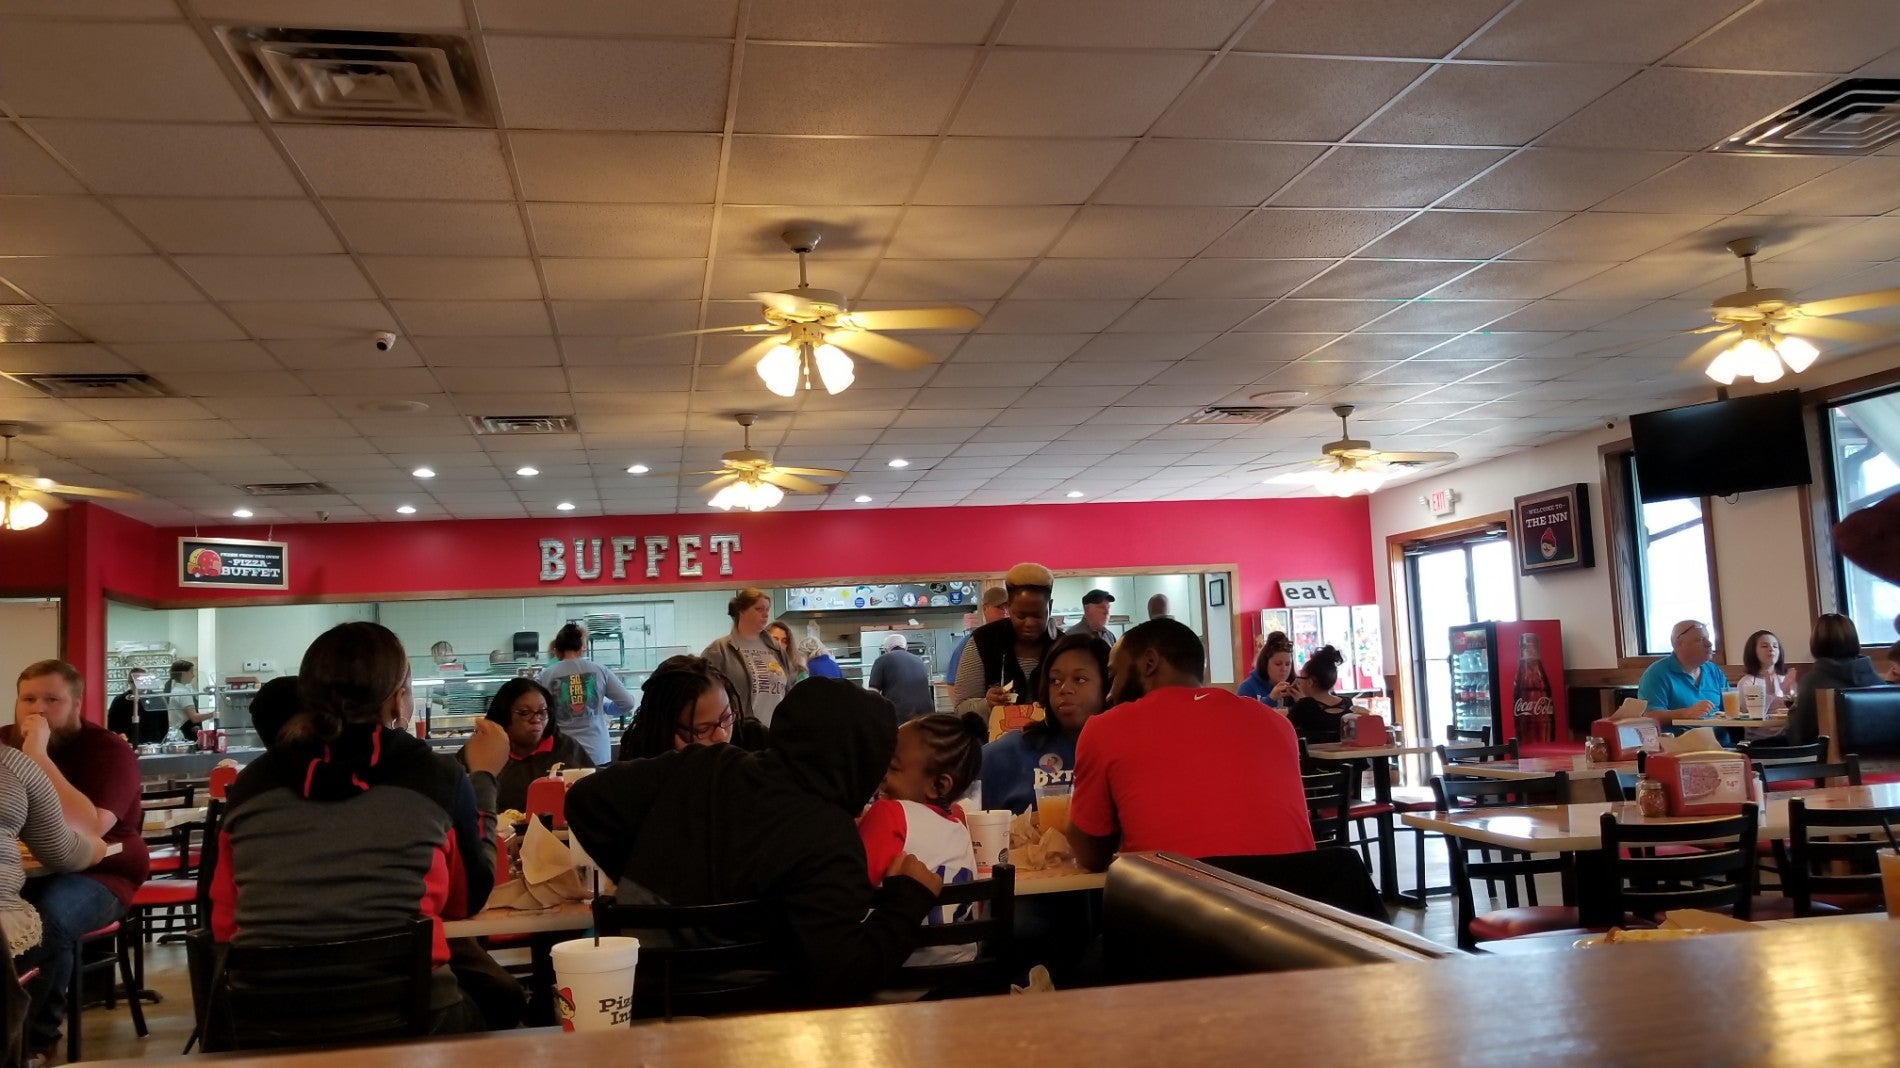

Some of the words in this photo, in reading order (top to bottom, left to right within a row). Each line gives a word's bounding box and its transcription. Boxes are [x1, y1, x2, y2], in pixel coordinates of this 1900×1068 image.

[1432, 491, 1445, 511] EXIT
[1525, 516, 1547, 528] THE
[1548, 511, 1568, 524] INN
[538, 533, 742, 581] BUFFET
[220, 566, 281, 578] BUFFET
[1285, 585, 1331, 601] eat
